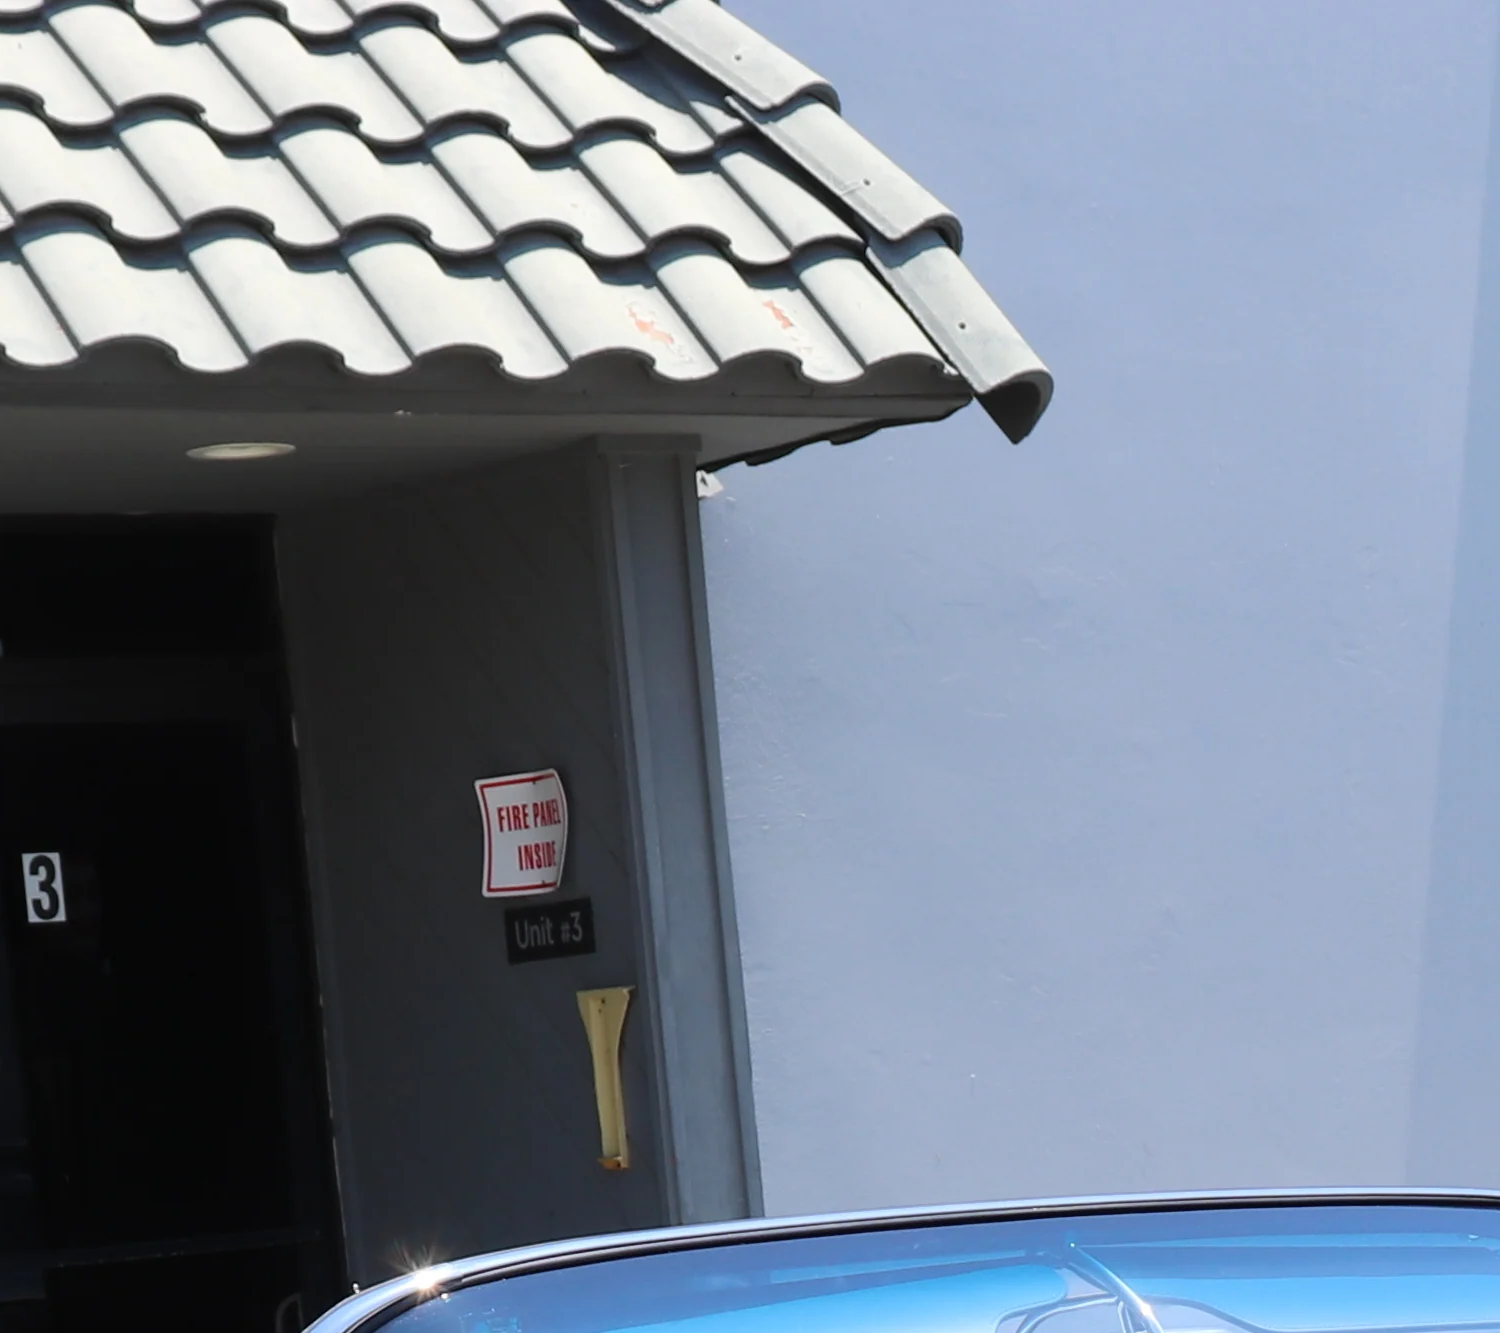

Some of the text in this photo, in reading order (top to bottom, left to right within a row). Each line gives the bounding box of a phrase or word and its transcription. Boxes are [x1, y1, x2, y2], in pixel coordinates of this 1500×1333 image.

[496, 798, 562, 833] FIRE PANEL
[517, 841, 557, 871] INSIDE
[28, 854, 60, 920] 3
[514, 911, 583, 950] Unit #3
